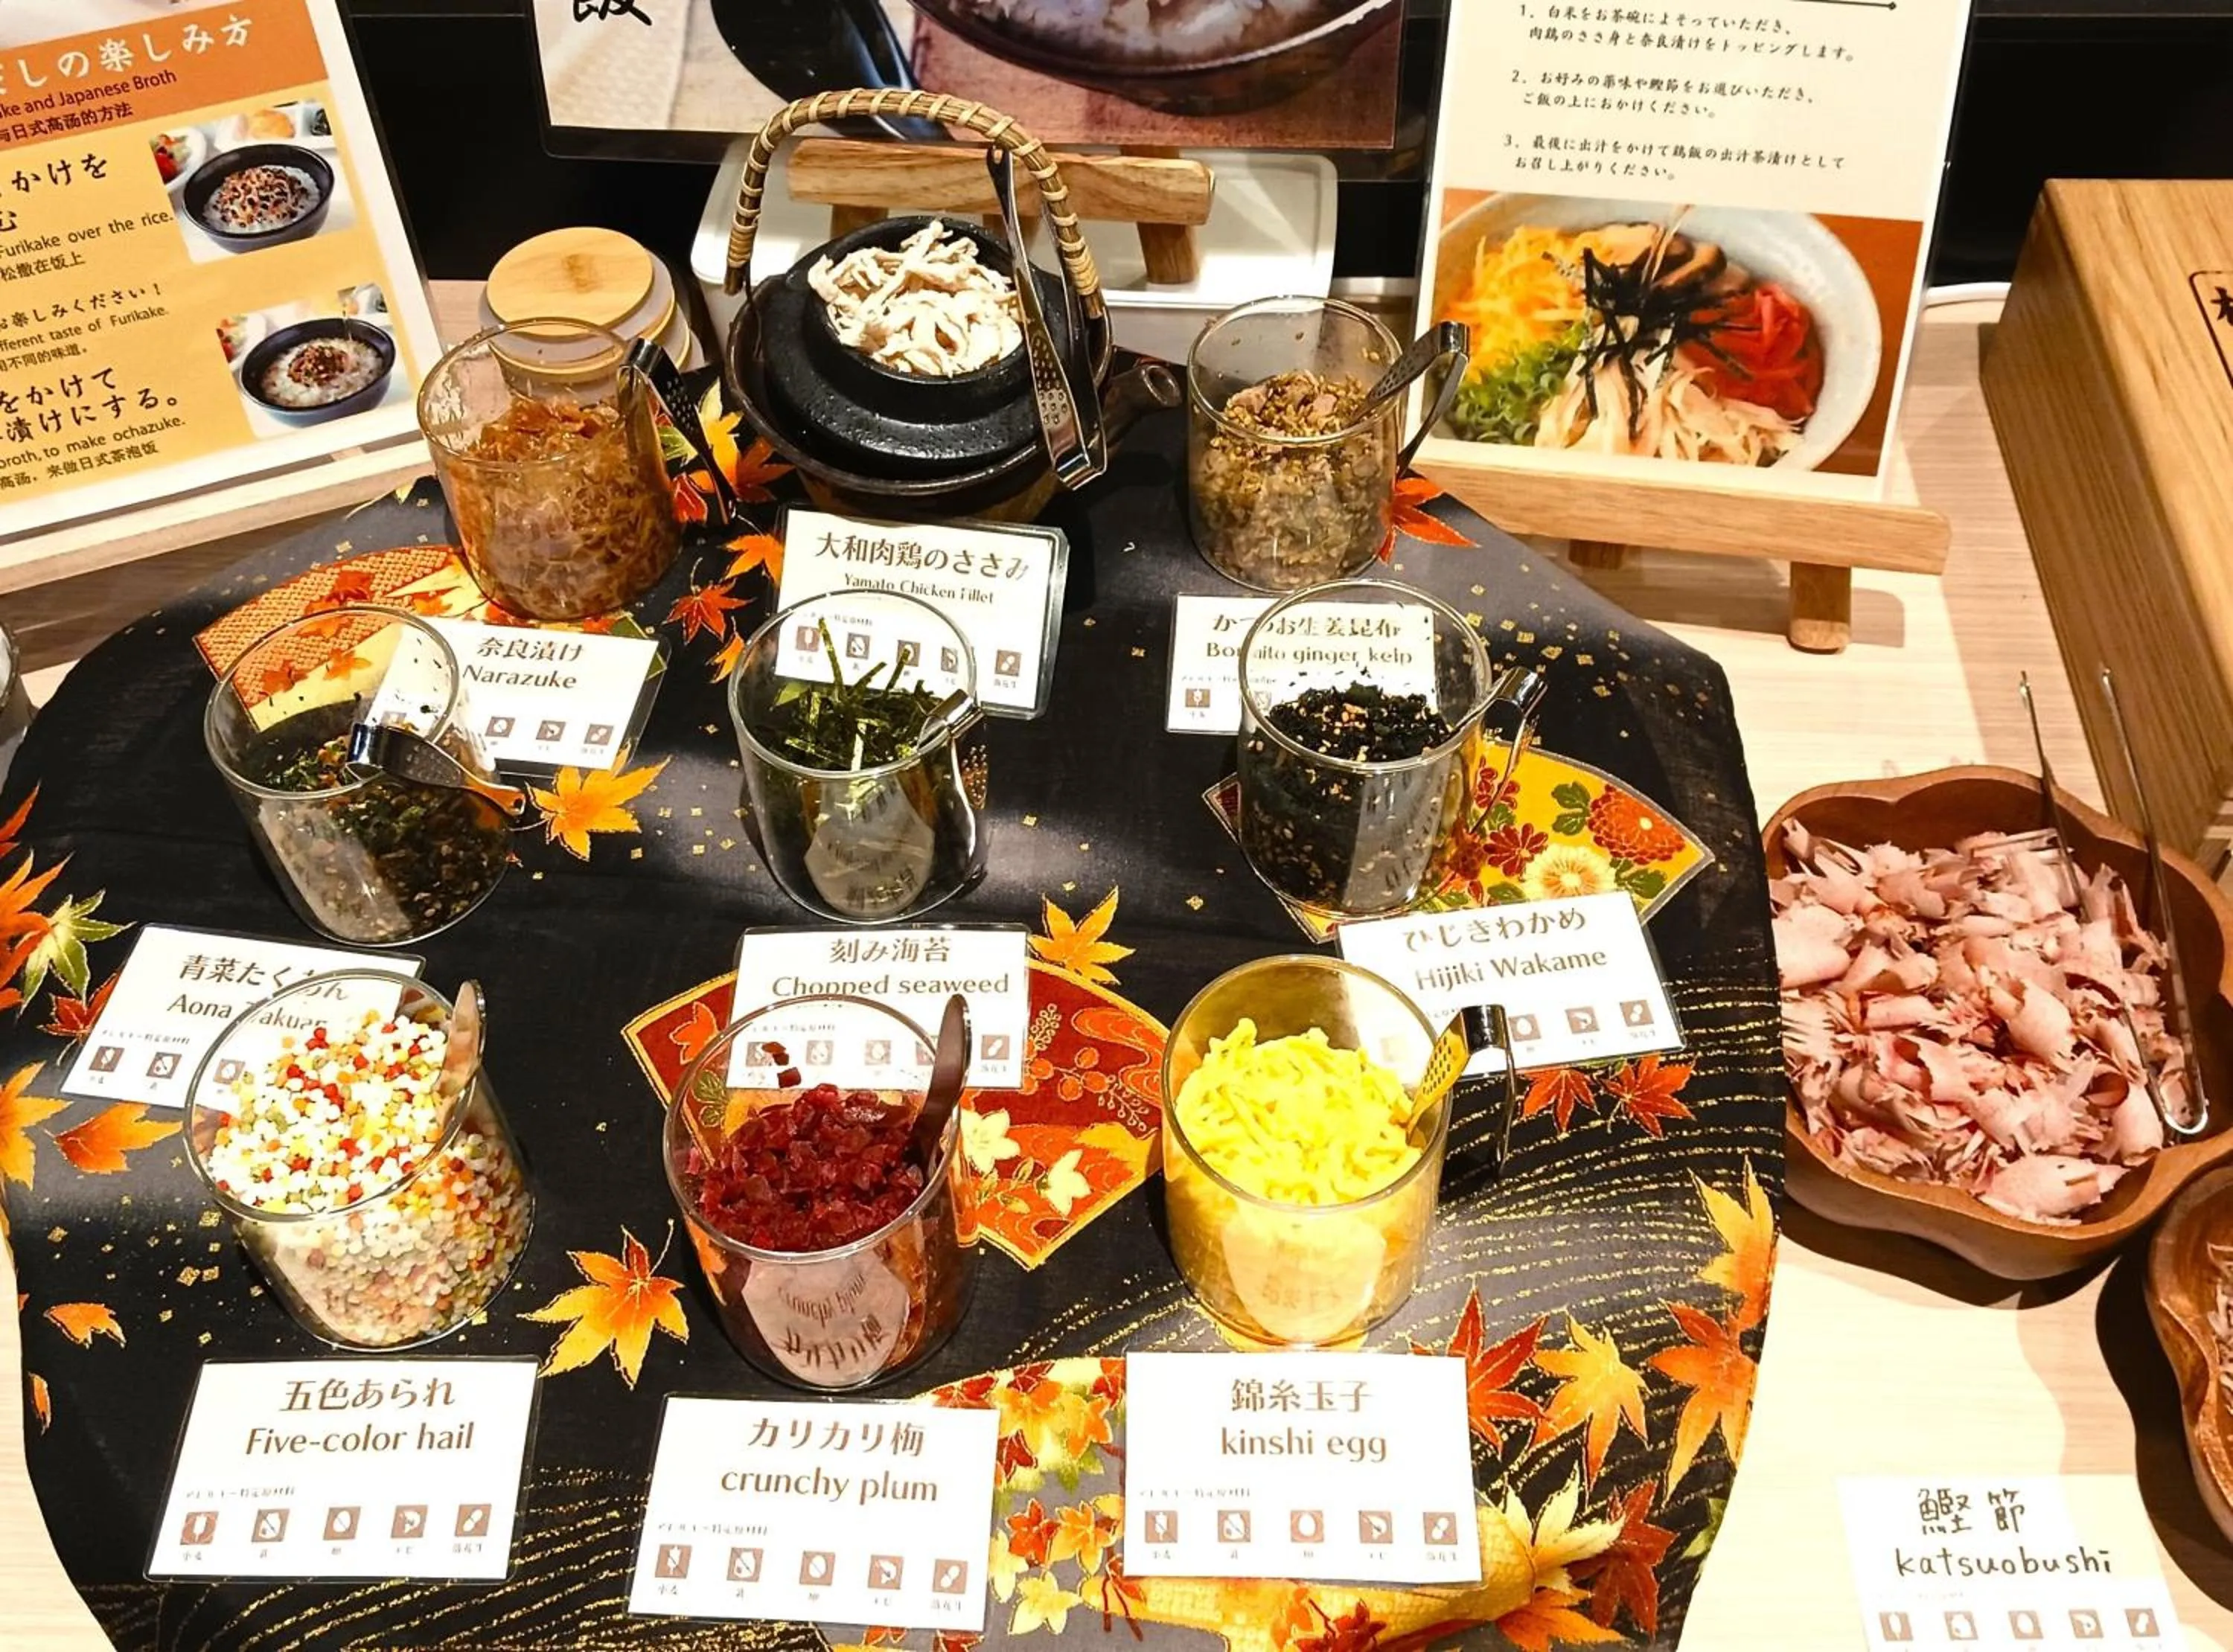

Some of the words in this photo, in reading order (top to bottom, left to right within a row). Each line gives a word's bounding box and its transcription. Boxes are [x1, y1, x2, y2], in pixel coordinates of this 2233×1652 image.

[0, 14, 252, 95] しの楽しみ方
[24, 93, 55, 113] and
[59, 80, 130, 106] Japanese
[132, 69, 177, 90] Broth
[68, 225, 101, 243] over
[108, 219, 135, 234] the
[141, 211, 174, 226] rice.
[49, 325, 83, 341] taste
[88, 318, 101, 332] of
[110, 306, 169, 327] Furikake.
[0, 388, 178, 444] 漬けにする。
[43, 446, 60, 458] to
[66, 435, 107, 453] make
[112, 417, 186, 441] ochazuke.
[815, 531, 1030, 581] 大和肉鶏のささみ
[844, 572, 895, 591] Yamato
[899, 579, 956, 600] Chicken
[477, 635, 584, 662] 奈良漬け
[1293, 646, 1358, 665] ginger
[1368, 646, 1413, 665] kelp
[462, 664, 577, 690] Narazuke
[1403, 907, 1586, 953] ひじきわかめ
[828, 937, 952, 964] 刻み海苔
[772, 974, 889, 996] Chopped
[898, 973, 1009, 994] seaweed
[1415, 961, 1486, 993] Hijiki
[1490, 950, 1609, 979] Wakame
[166, 993, 233, 1019] Aona
[279, 1377, 457, 1412] 五色あられ
[1230, 1378, 1376, 1413] 錦糸玉子
[246, 1424, 408, 1455] Five-color
[417, 1421, 476, 1450] hail
[747, 1417, 926, 1458] カリカリ梅
[1220, 1427, 1314, 1456] kinshi
[1326, 1435, 1387, 1463] egg
[721, 1467, 849, 1502] crunchy
[858, 1470, 938, 1505] plum
[1894, 1546, 2112, 1577] katsuobushi
